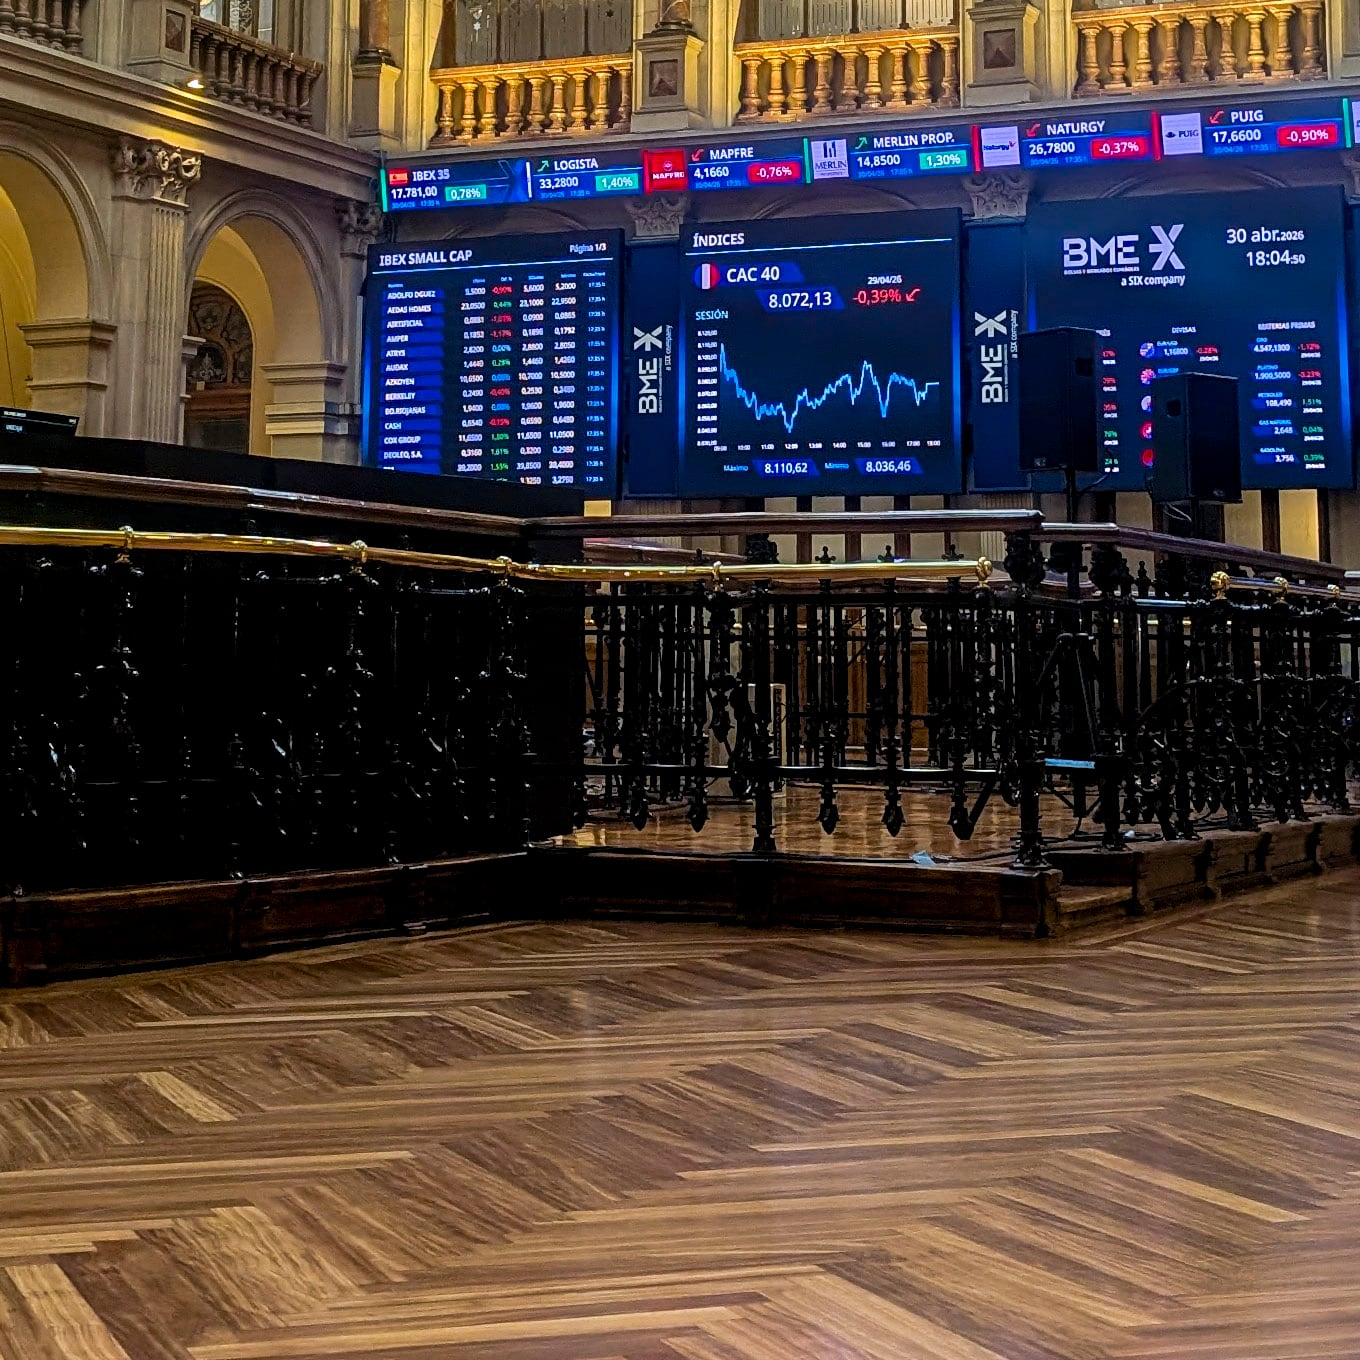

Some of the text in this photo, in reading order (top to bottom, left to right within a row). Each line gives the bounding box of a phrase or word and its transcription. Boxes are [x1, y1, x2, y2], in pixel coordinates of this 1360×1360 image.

[1231, 110, 1263, 124] PUIG
[1046, 121, 1105, 136] NATURGY
[873, 132, 955, 149] MERLIN PROP.
[1212, 129, 1329, 144] 17,6600 -0,90%
[710, 147, 754, 160] MAPFRE
[1029, 141, 1139, 156] 26,7800 -0,37%
[554, 158, 598, 171] LOGISTA
[814, 160, 846, 171] MERLIN
[857, 154, 961, 168] 14,8500 1,30%
[412, 169, 450, 182] IBEX 35
[694, 166, 792, 179] 4,1660 -0,76%
[539, 177, 633, 189] 33,2800 1,40%
[391, 187, 480, 201] 17.781,00 0,78%
[693, 233, 745, 248] ÍNDICES
[1226, 228, 1246, 244] 30
[379, 250, 472, 266] IBEX SMALL CAP
[1063, 234, 1140, 268] BME
[726, 266, 780, 283] CAC 40
[1121, 274, 1186, 287] a SIX company
[769, 292, 832, 309] 8.072,13
[852, 289, 902, 306] -0,39%
[695, 309, 729, 321] SESIÓN
[981, 345, 1002, 403] BME
[639, 358, 657, 413] BME
[764, 463, 808, 475] 8.110,62
[866, 460, 911, 473] 8.036,46
